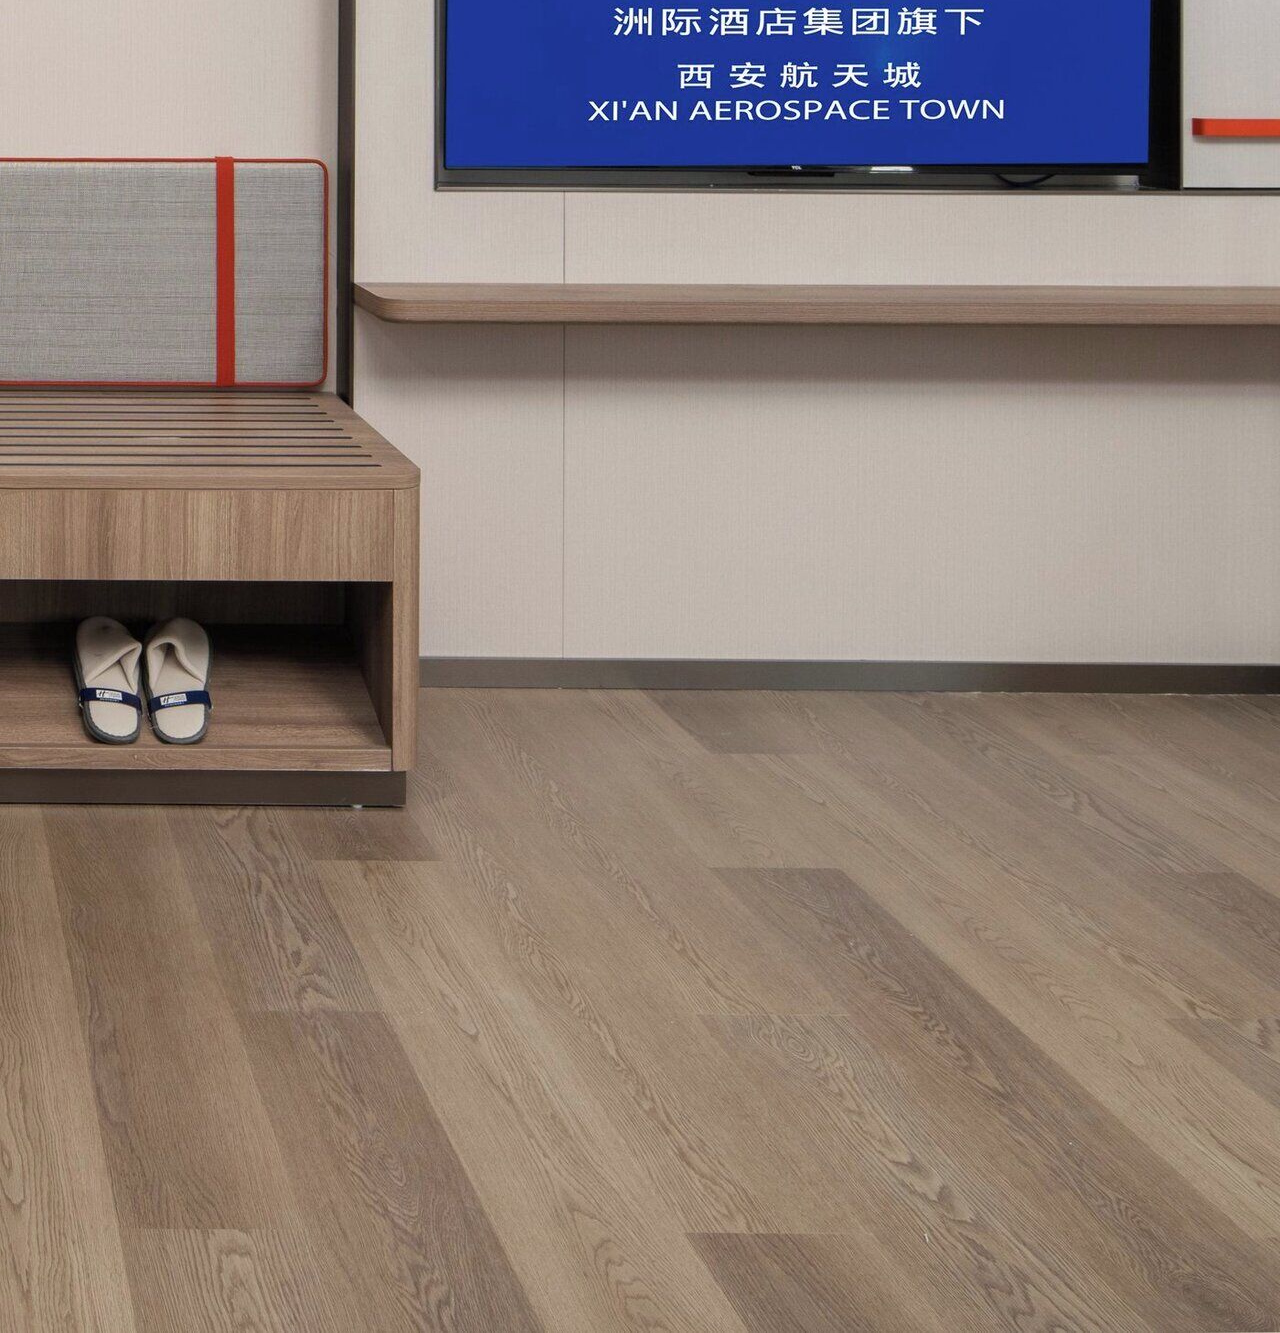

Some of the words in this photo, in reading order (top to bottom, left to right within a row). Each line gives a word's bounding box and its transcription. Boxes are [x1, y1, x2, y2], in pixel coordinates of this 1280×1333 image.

[613, 7, 985, 36] 洲际酒店集团旗下
[588, 100, 678, 121] XI'AN
[689, 99, 890, 121] AEROSPACE
[899, 99, 1004, 120] TOWN
